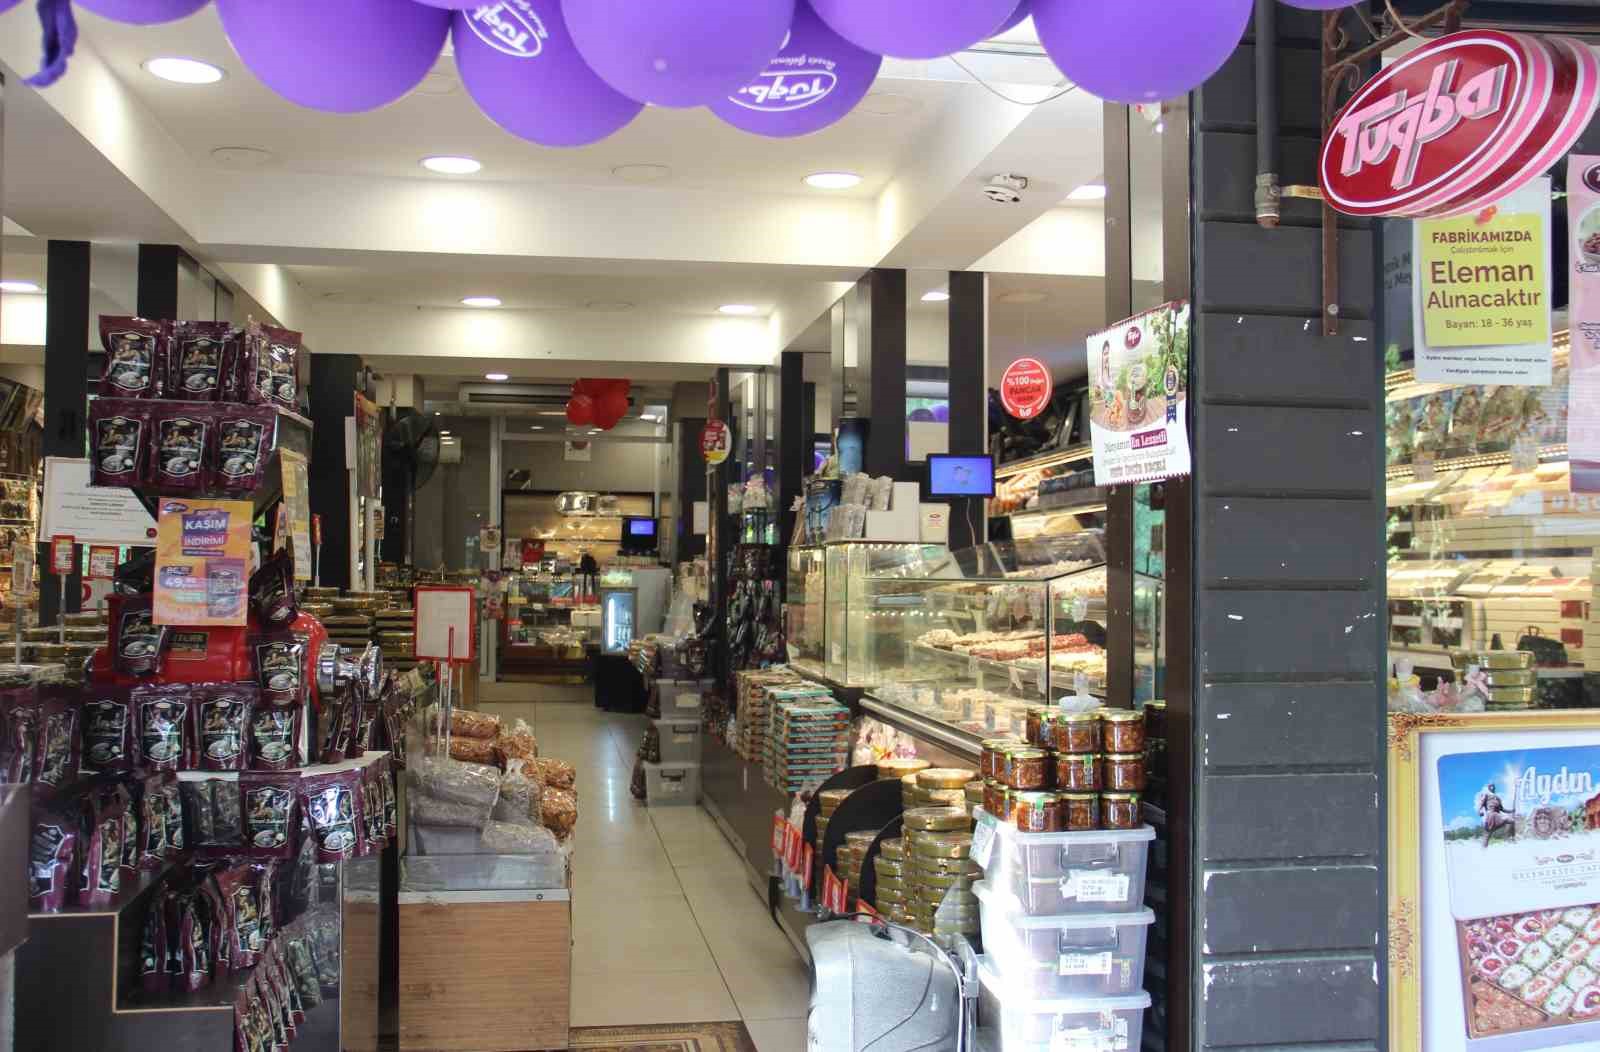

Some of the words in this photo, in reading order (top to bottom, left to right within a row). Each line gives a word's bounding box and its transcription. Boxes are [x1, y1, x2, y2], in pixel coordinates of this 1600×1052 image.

[1432, 229, 1532, 244] FABRİKAMIZDA
[1431, 261, 1534, 284] Eleman
[1427, 288, 1542, 309] Alınacaktır
[1445, 319, 1478, 331] Bayan:
[1481, 318, 1492, 328] 18
[1502, 318, 1513, 327] 36
[1515, 319, 1532, 329] yaş
[185, 519, 226, 530] KASIM
[1517, 766, 1592, 804] Aydın
